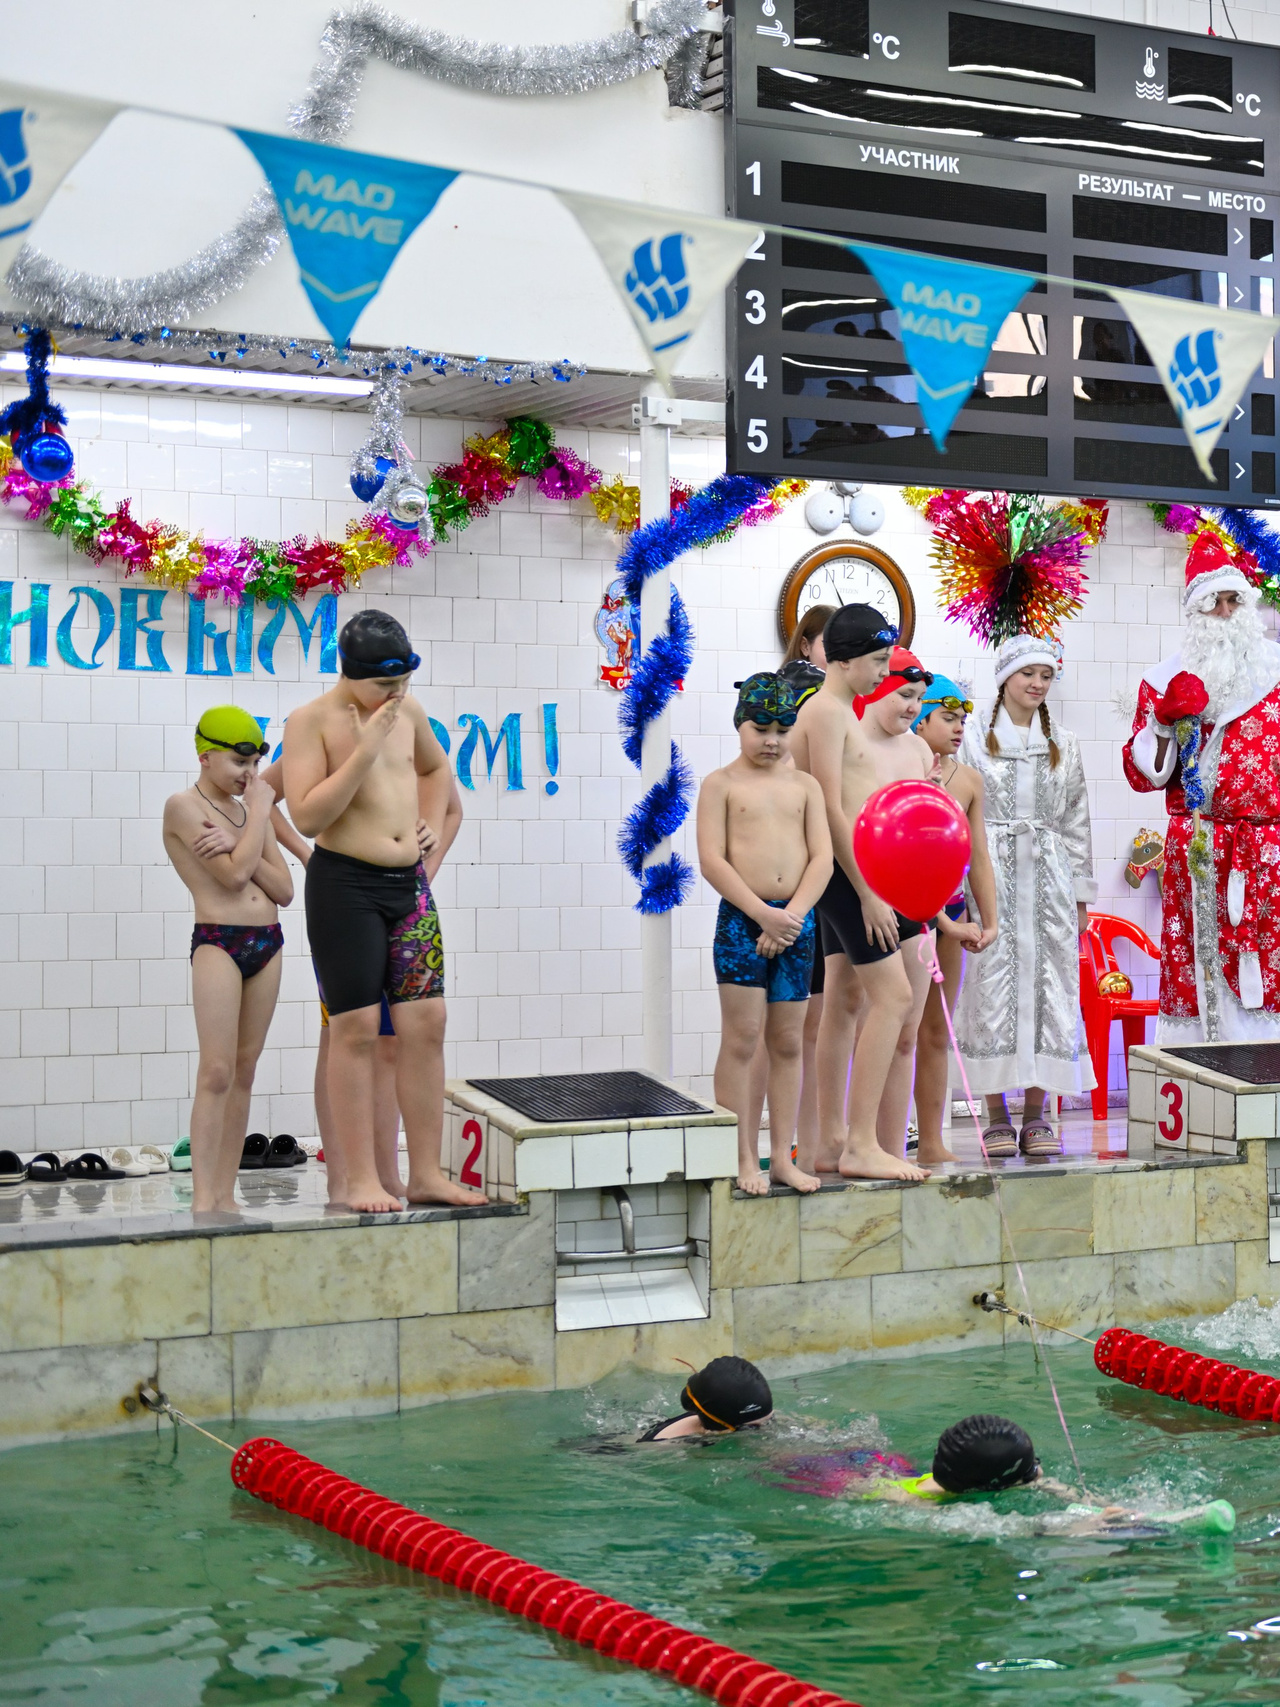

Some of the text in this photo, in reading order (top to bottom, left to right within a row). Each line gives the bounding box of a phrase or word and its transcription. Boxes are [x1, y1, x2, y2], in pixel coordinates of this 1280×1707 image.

[859, 144, 960, 175] УЧАСТНИК
[294, 168, 396, 212] MAD
[745, 161, 761, 196] 1
[1078, 173, 1175, 201] РЕЗУЛЬТАТ
[1208, 191, 1266, 213] МЕСТО
[284, 197, 404, 245] WAVE
[744, 229, 766, 261] 2
[745, 289, 767, 325] 3
[901, 281, 982, 318] MAD
[896, 305, 989, 348] WAVE
[744, 355, 768, 389] 4
[746, 418, 769, 453] 5
[842, 564, 855, 580] 12
[866, 572, 870, 587] 1
[809, 584, 822, 599] 10
[876, 589, 886, 604] 2
[0, 581, 339, 677] НОВЫМ
[1158, 1082, 1183, 1142] 3
[460, 1119, 483, 1189] 2
